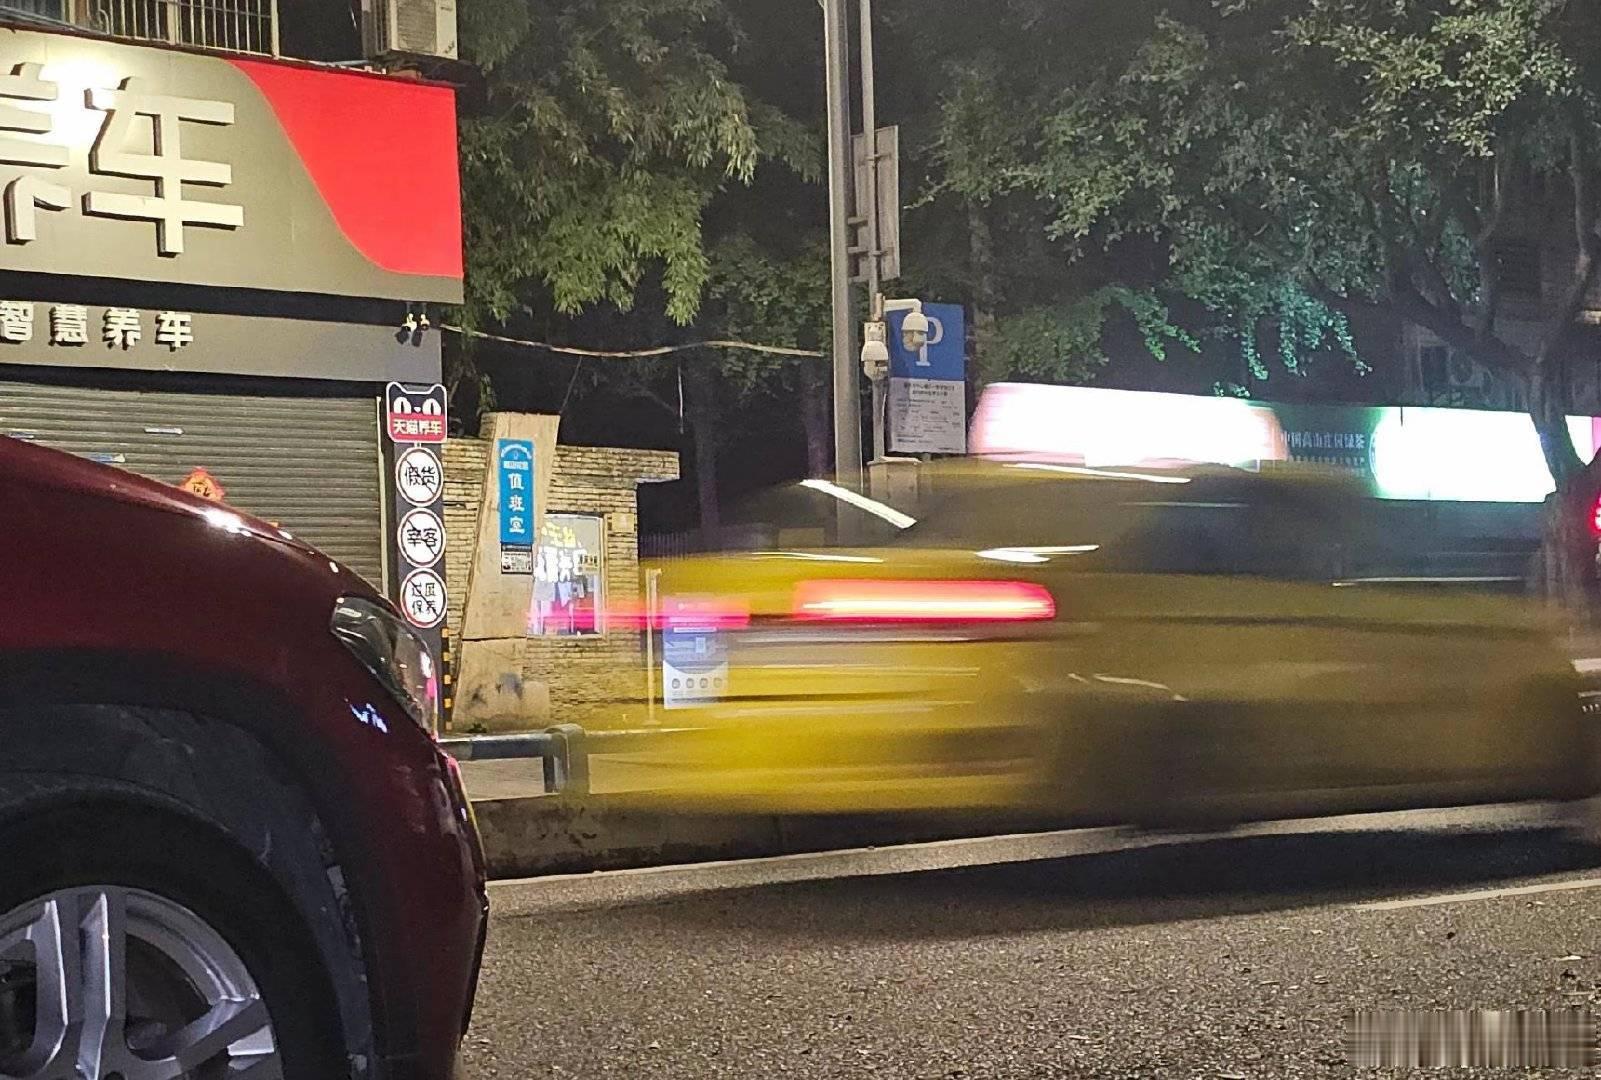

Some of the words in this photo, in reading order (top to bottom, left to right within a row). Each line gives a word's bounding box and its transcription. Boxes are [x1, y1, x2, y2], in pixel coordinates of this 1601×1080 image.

[0, 301, 194, 348] 智慧养车
[393, 418, 443, 436] 天猫养车
[404, 466, 436, 486] 假货
[507, 472, 525, 534] 值班室
